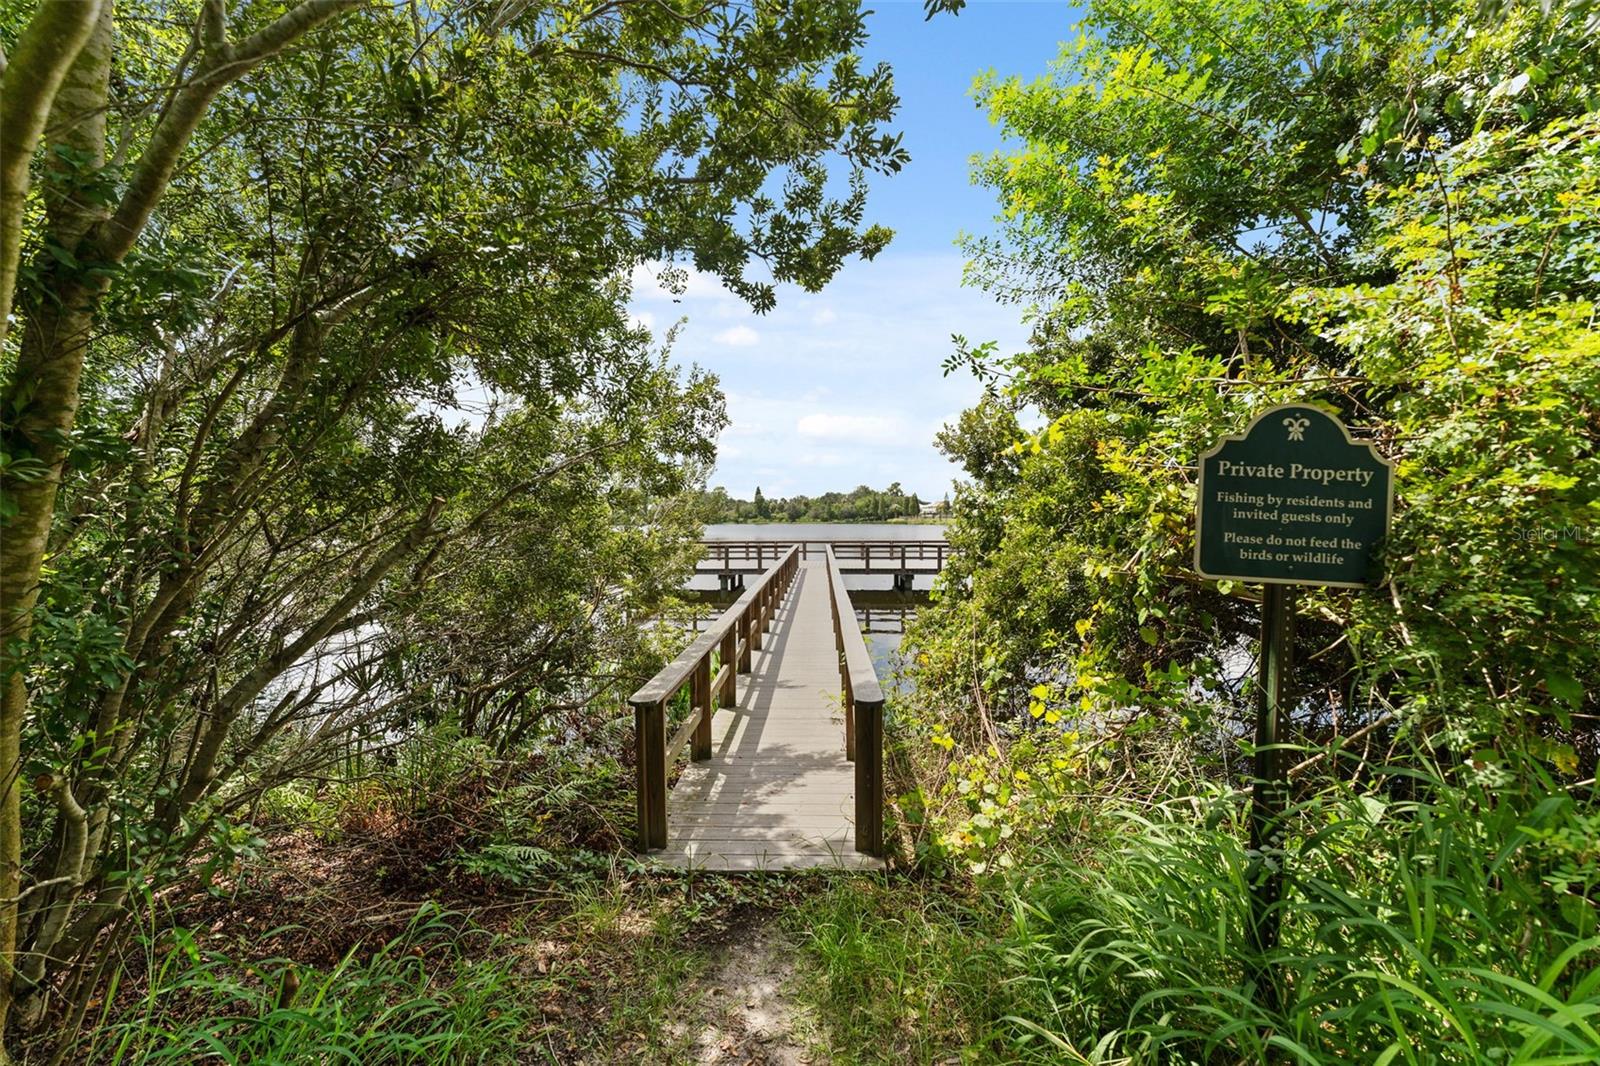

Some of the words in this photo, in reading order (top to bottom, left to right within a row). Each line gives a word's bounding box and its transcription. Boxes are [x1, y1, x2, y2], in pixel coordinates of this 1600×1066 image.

[1217, 460, 1284, 479] Private
[1289, 463, 1374, 487] Property
[1217, 491, 1264, 507] Fishing
[1267, 493, 1284, 508] by
[1286, 495, 1345, 509] residents
[1347, 498, 1373, 510] and
[1233, 508, 1279, 521] invited
[1281, 510, 1322, 524] guests
[1325, 513, 1355, 527] only
[1223, 532, 1263, 545] Please
[1266, 533, 1282, 546] do
[1285, 535, 1307, 547] not
[1310, 536, 1338, 549] feed
[1341, 538, 1362, 550] the
[1239, 548, 1273, 561] birds
[1276, 551, 1290, 562] or
[1293, 551, 1345, 565] wildlife
